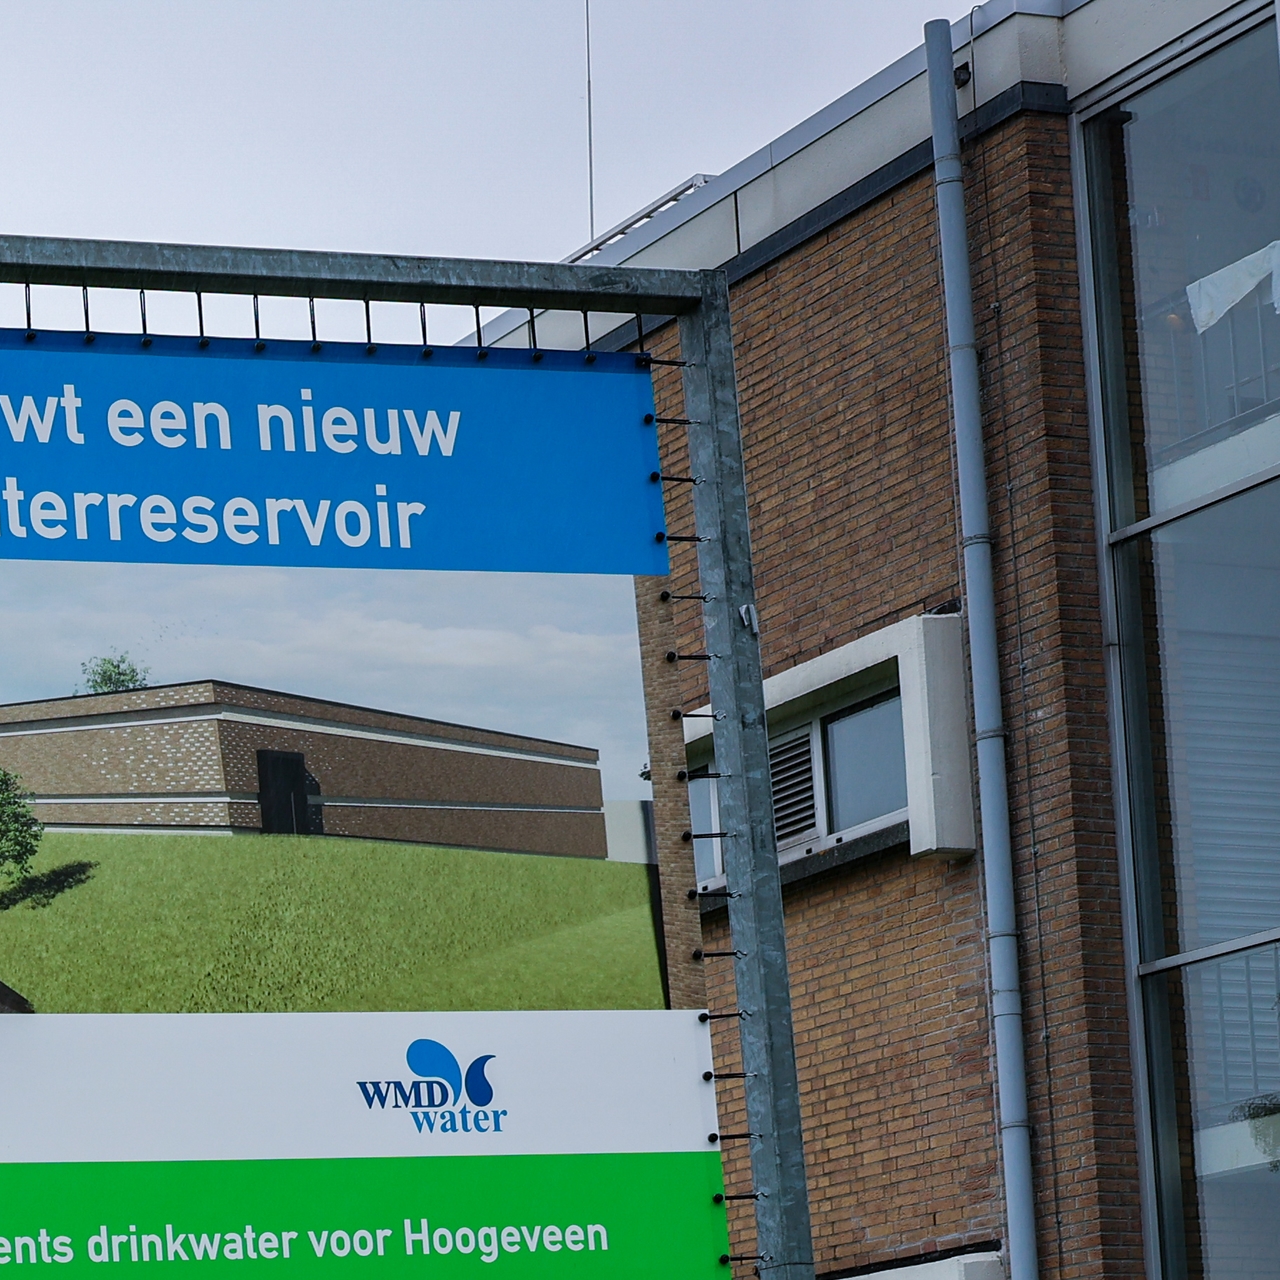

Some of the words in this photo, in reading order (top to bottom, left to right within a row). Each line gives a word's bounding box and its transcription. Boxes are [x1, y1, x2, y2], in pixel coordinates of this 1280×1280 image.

[107, 399, 232, 450] een
[257, 388, 461, 457] nieuw
[356, 1080, 449, 1110] WMD
[409, 1103, 508, 1134] water
[87, 1224, 298, 1263] drinkwater
[307, 1229, 393, 1258] voor
[404, 1218, 608, 1262] Hoogeveen
